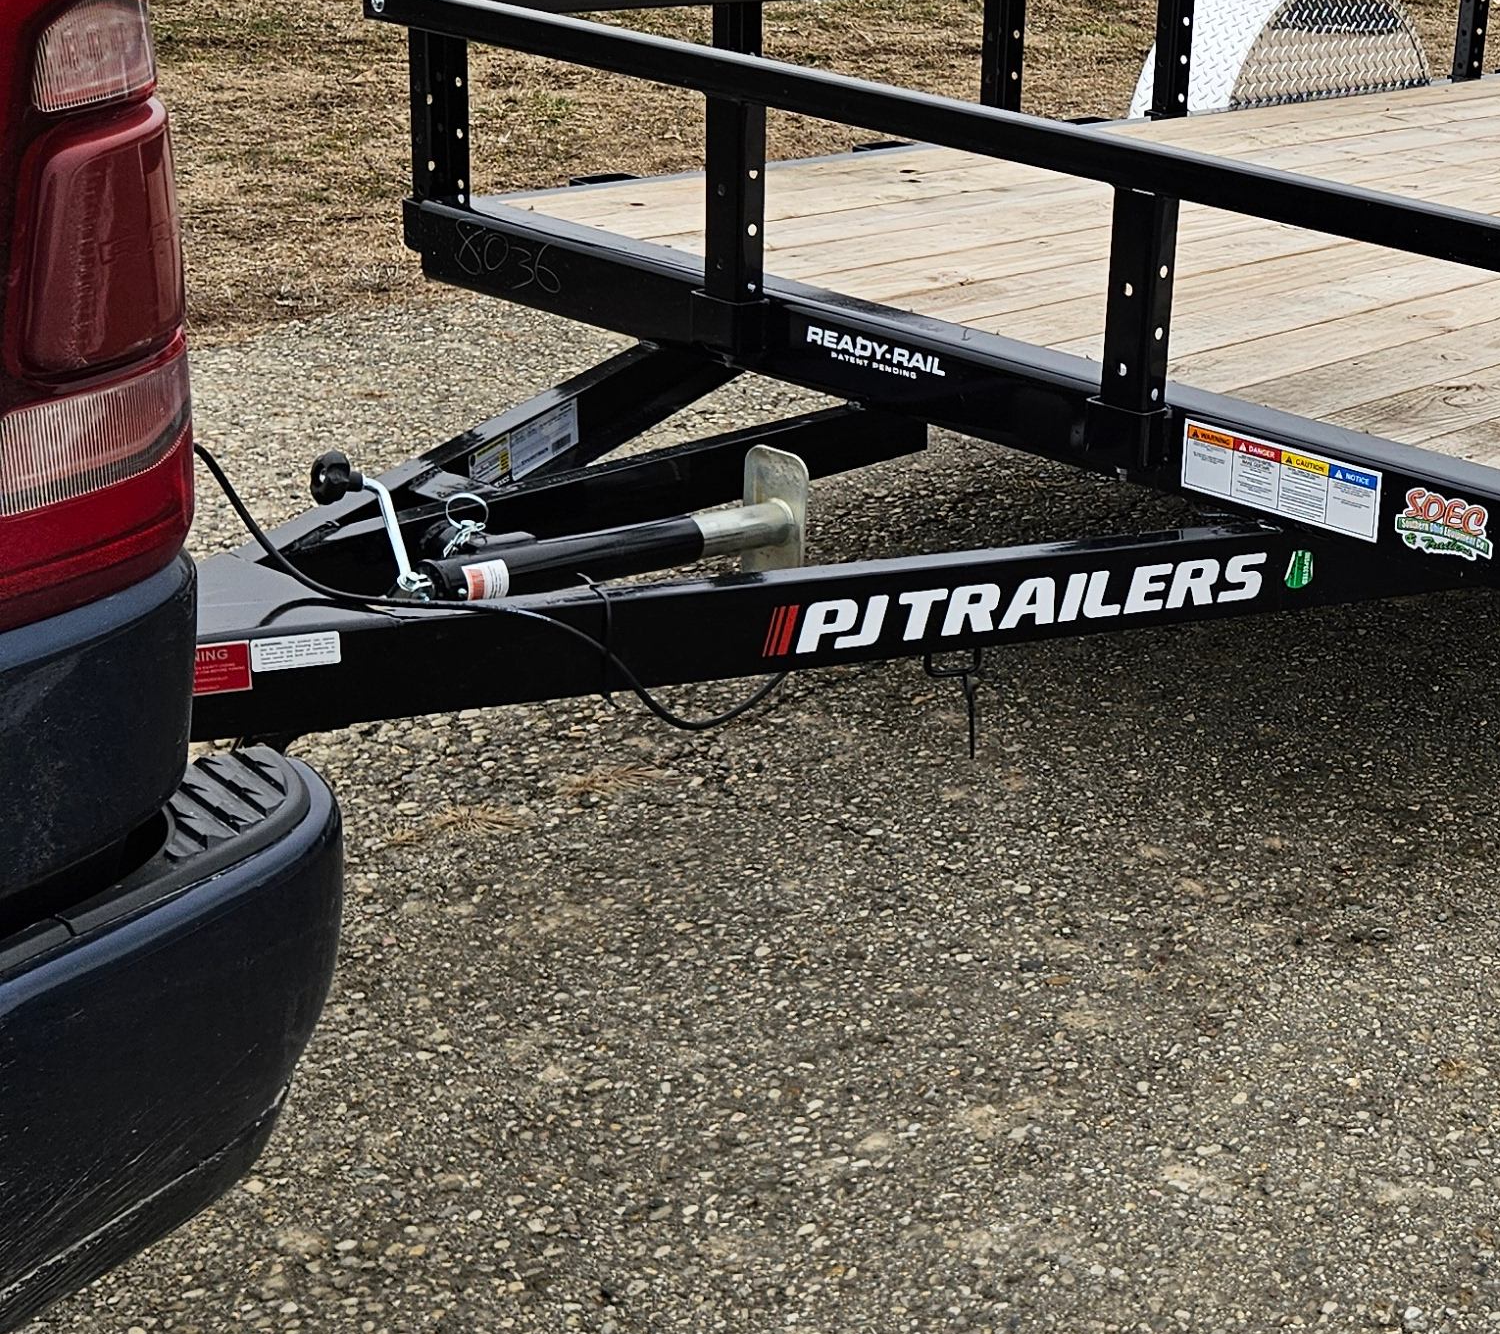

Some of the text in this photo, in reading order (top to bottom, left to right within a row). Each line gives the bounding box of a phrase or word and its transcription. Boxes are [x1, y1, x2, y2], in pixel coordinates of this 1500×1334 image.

[455, 218, 561, 293] 8036
[830, 351, 917, 379] PATENT PENDING
[1200, 433, 1230, 446] WARNING
[1248, 445, 1275, 458] DANGER
[1295, 458, 1325, 473] CAUTION
[1345, 472, 1370, 486] NOTICE
[1404, 489, 1486, 537] SOEC
[795, 552, 1267, 654] PJ TRAILERS
[195, 649, 229, 663] NING
